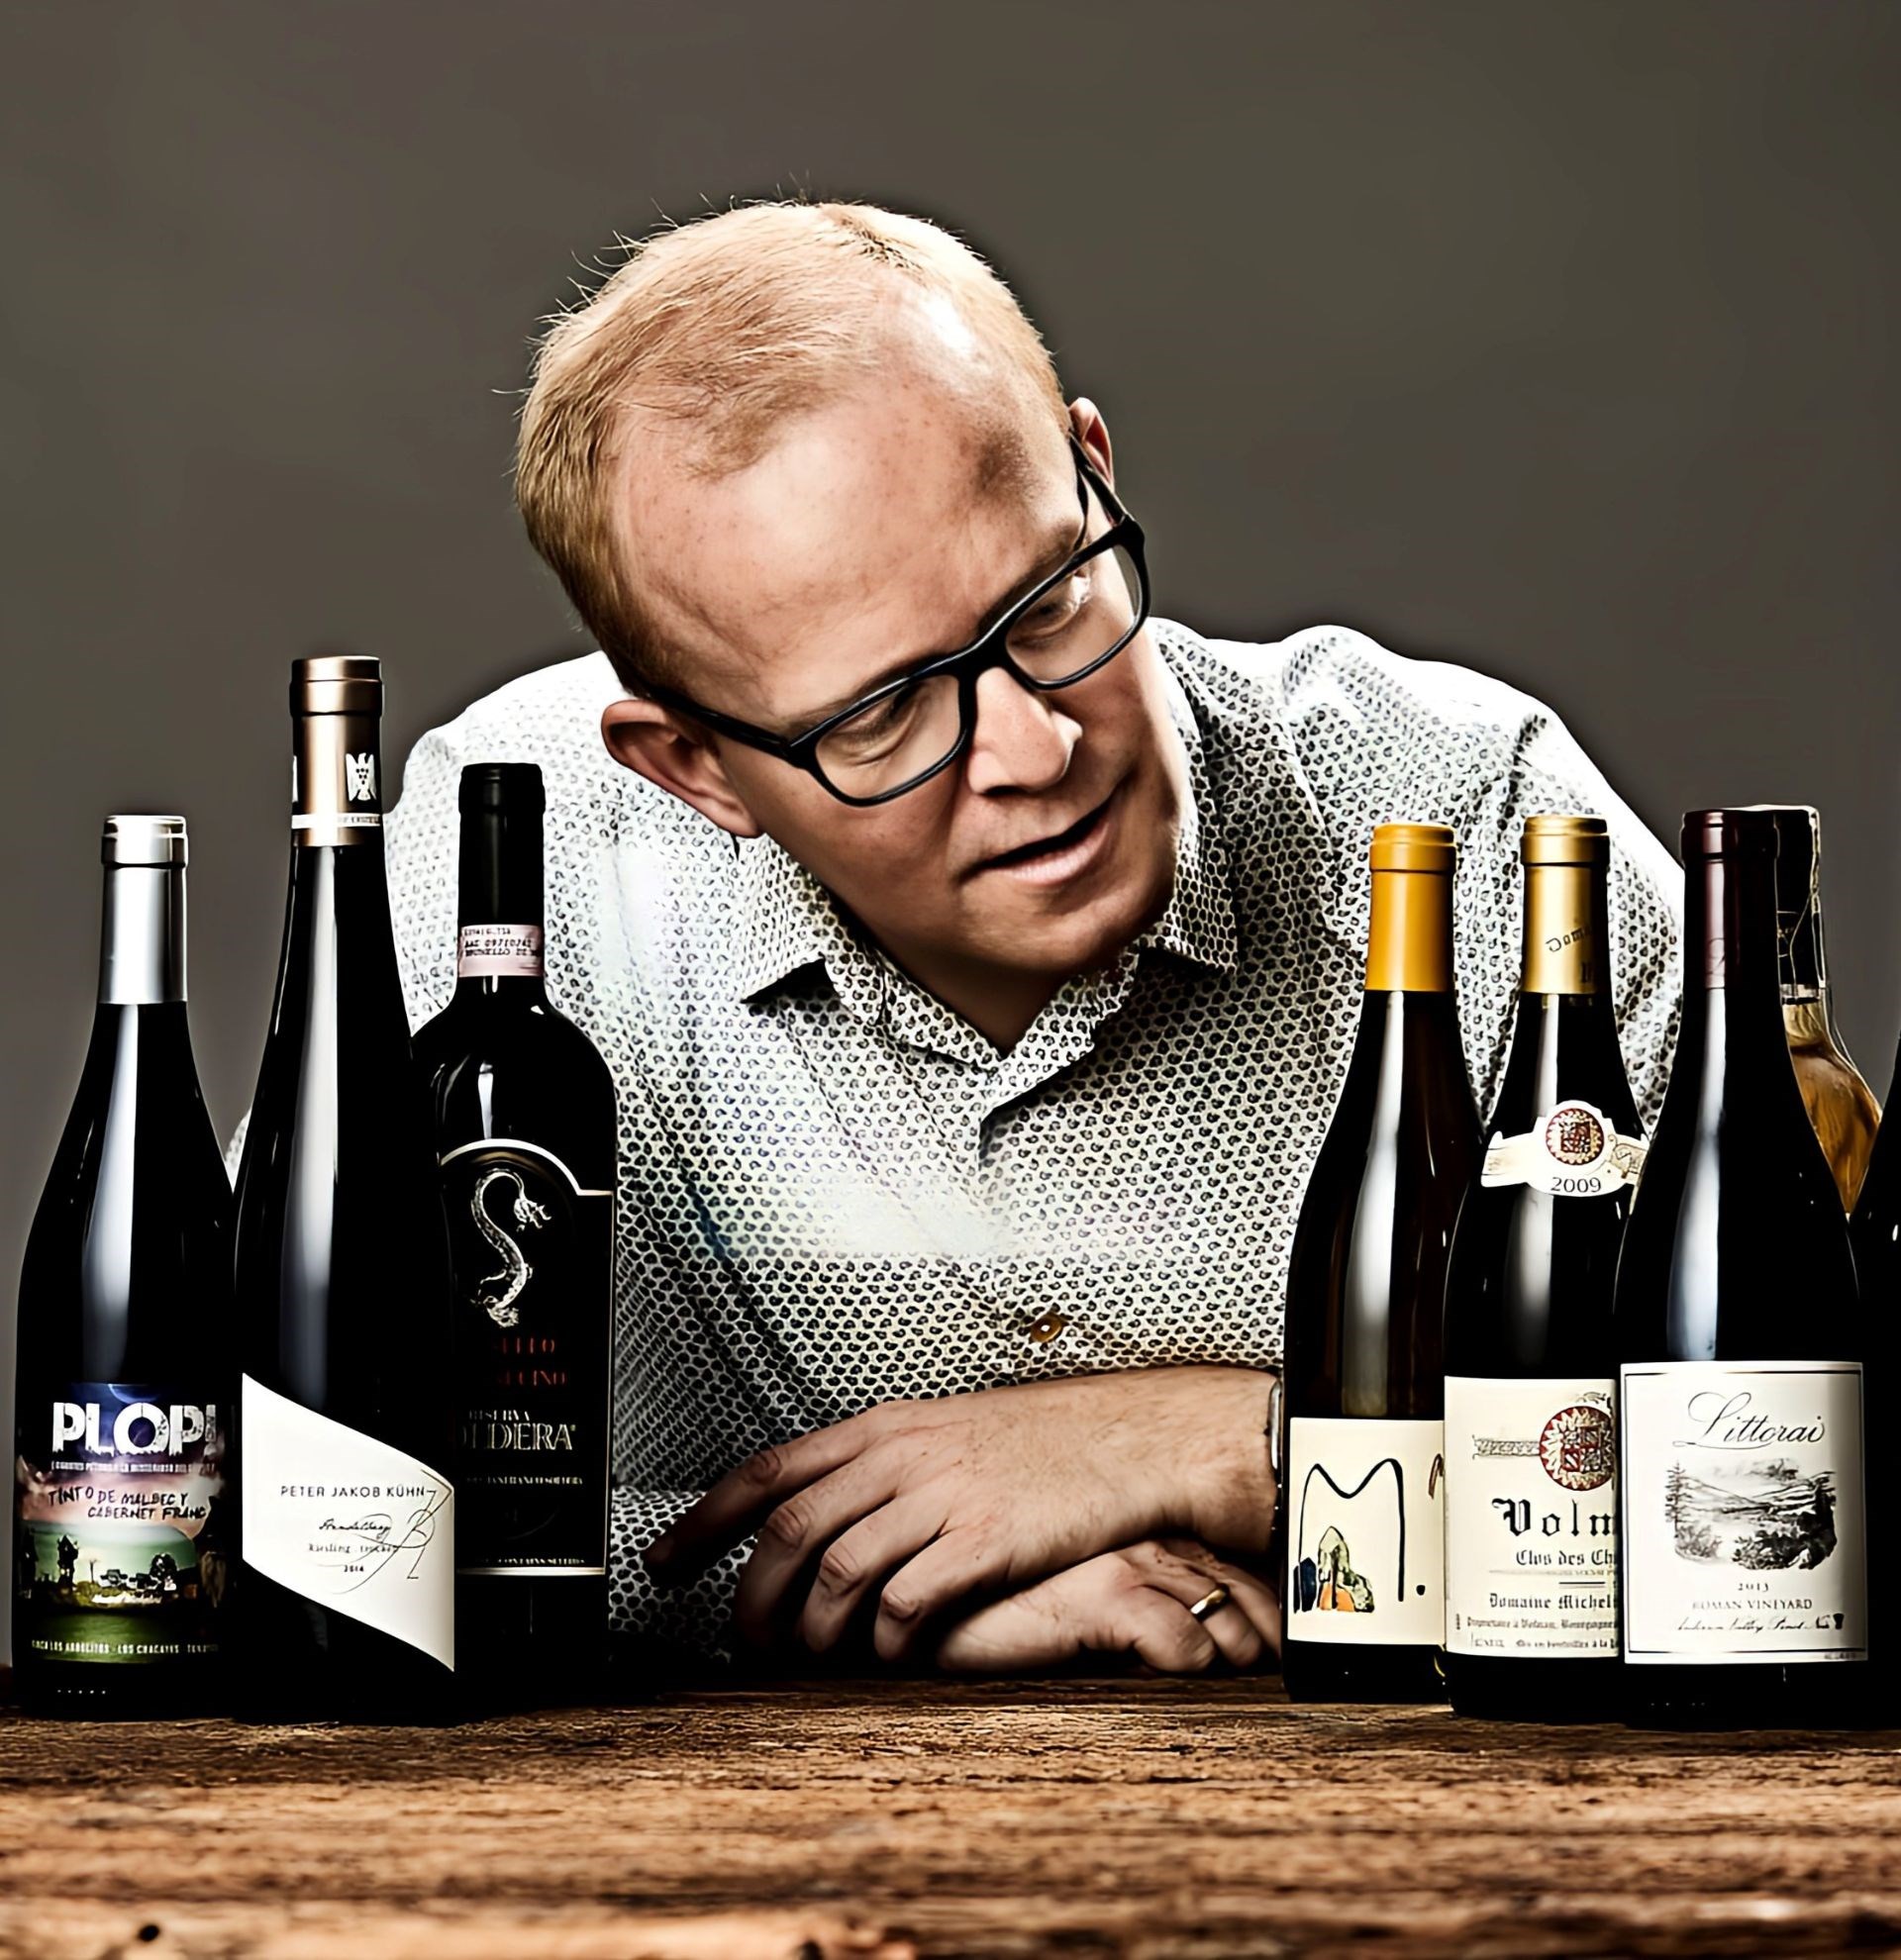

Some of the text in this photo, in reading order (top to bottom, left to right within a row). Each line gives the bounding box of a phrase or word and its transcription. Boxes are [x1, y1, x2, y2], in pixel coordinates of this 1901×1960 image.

[1551, 1176, 1602, 1194] 2009
[1672, 1391, 1825, 1450] Littorai
[51, 1402, 217, 1457] PLOP!
[49, 1485, 189, 1507] TINTO DE MALBEC Y
[280, 1484, 425, 1498] PETER JAKOB KÜHN
[87, 1507, 207, 1520] CABERNET FRANC
[1516, 1549, 1552, 1566] Clos
[1558, 1550, 1585, 1566] des
[1489, 1593, 1551, 1609] Domaine
